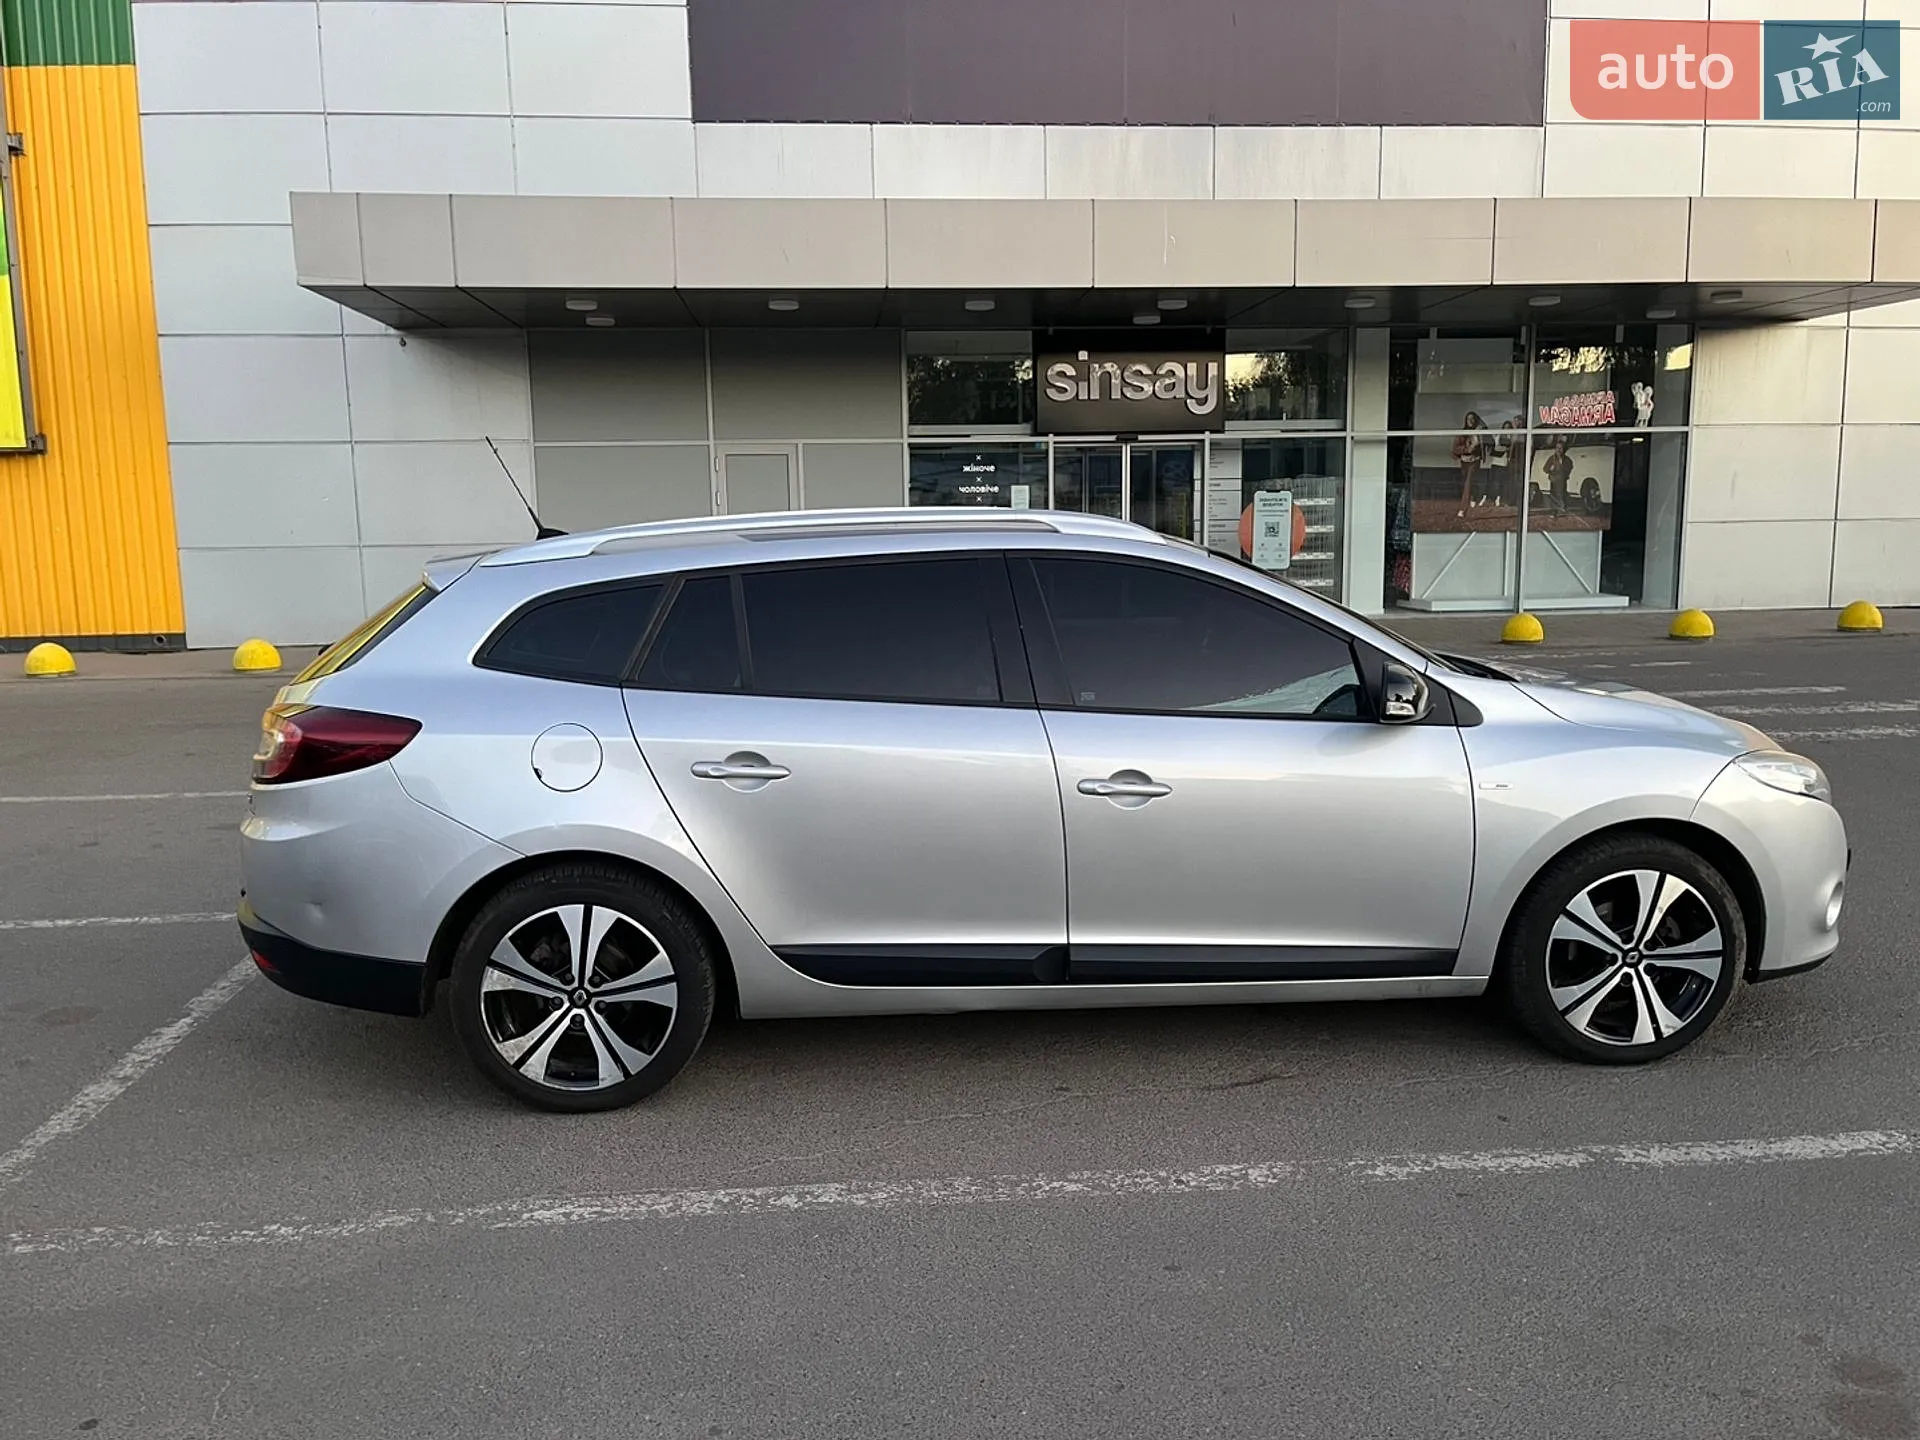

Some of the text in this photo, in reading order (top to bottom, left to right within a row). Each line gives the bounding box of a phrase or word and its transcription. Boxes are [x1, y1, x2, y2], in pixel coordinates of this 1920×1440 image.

[1045, 350, 1220, 415] sinsay
[962, 463, 996, 473] жіноче
[958, 484, 1000, 494] чоловіче
